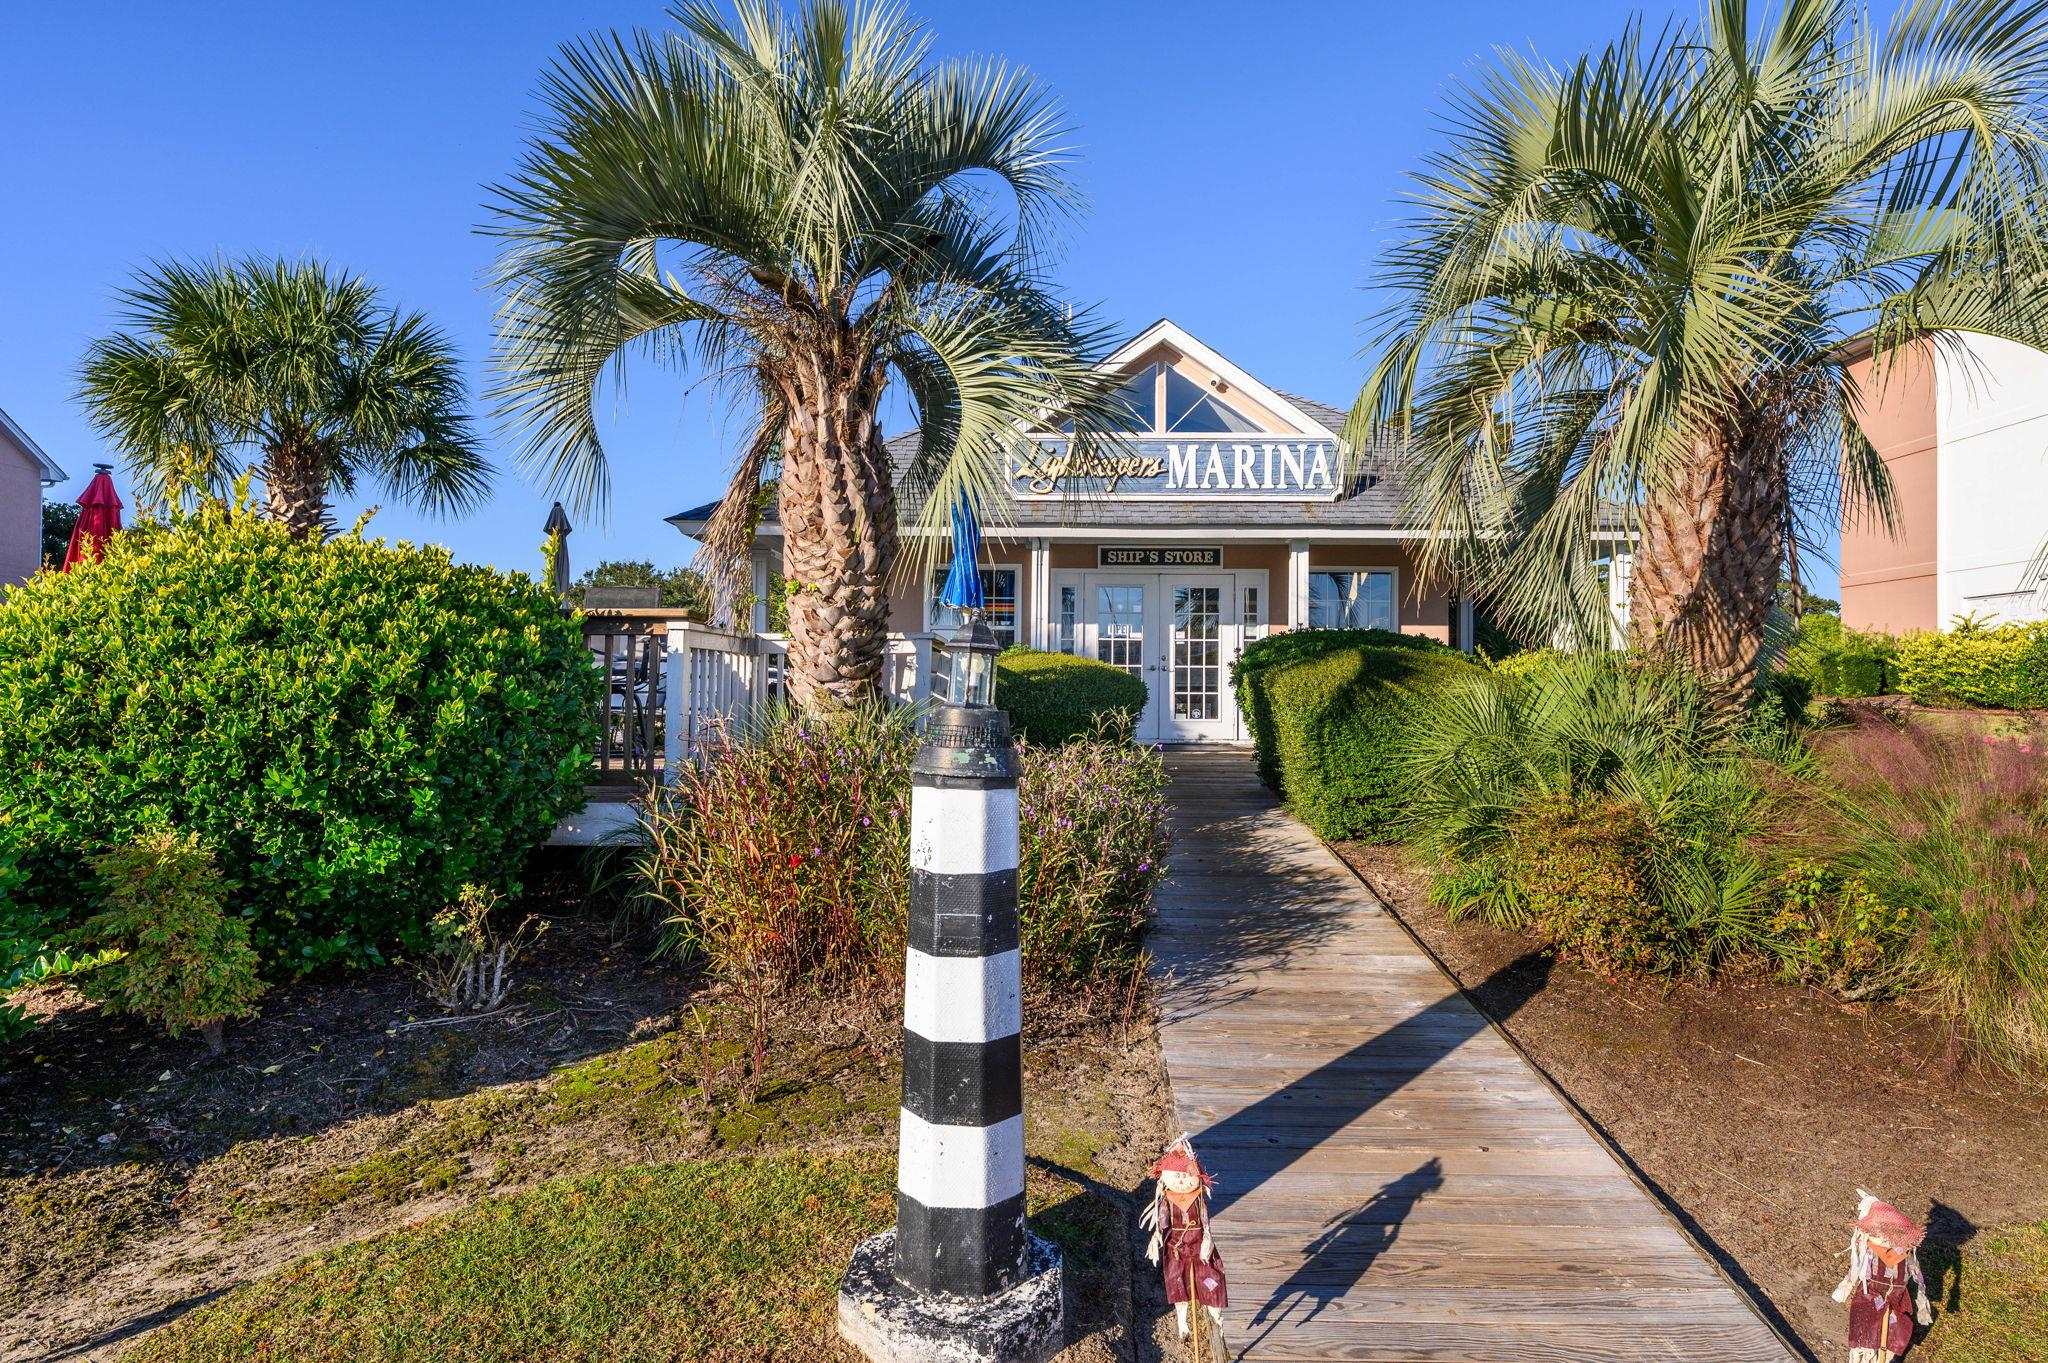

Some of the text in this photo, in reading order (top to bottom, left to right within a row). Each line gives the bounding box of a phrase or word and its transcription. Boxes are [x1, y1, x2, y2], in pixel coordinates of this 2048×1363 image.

[1165, 443, 1334, 490] MARINA
[1107, 551, 1214, 563] SHIP'S STORE
